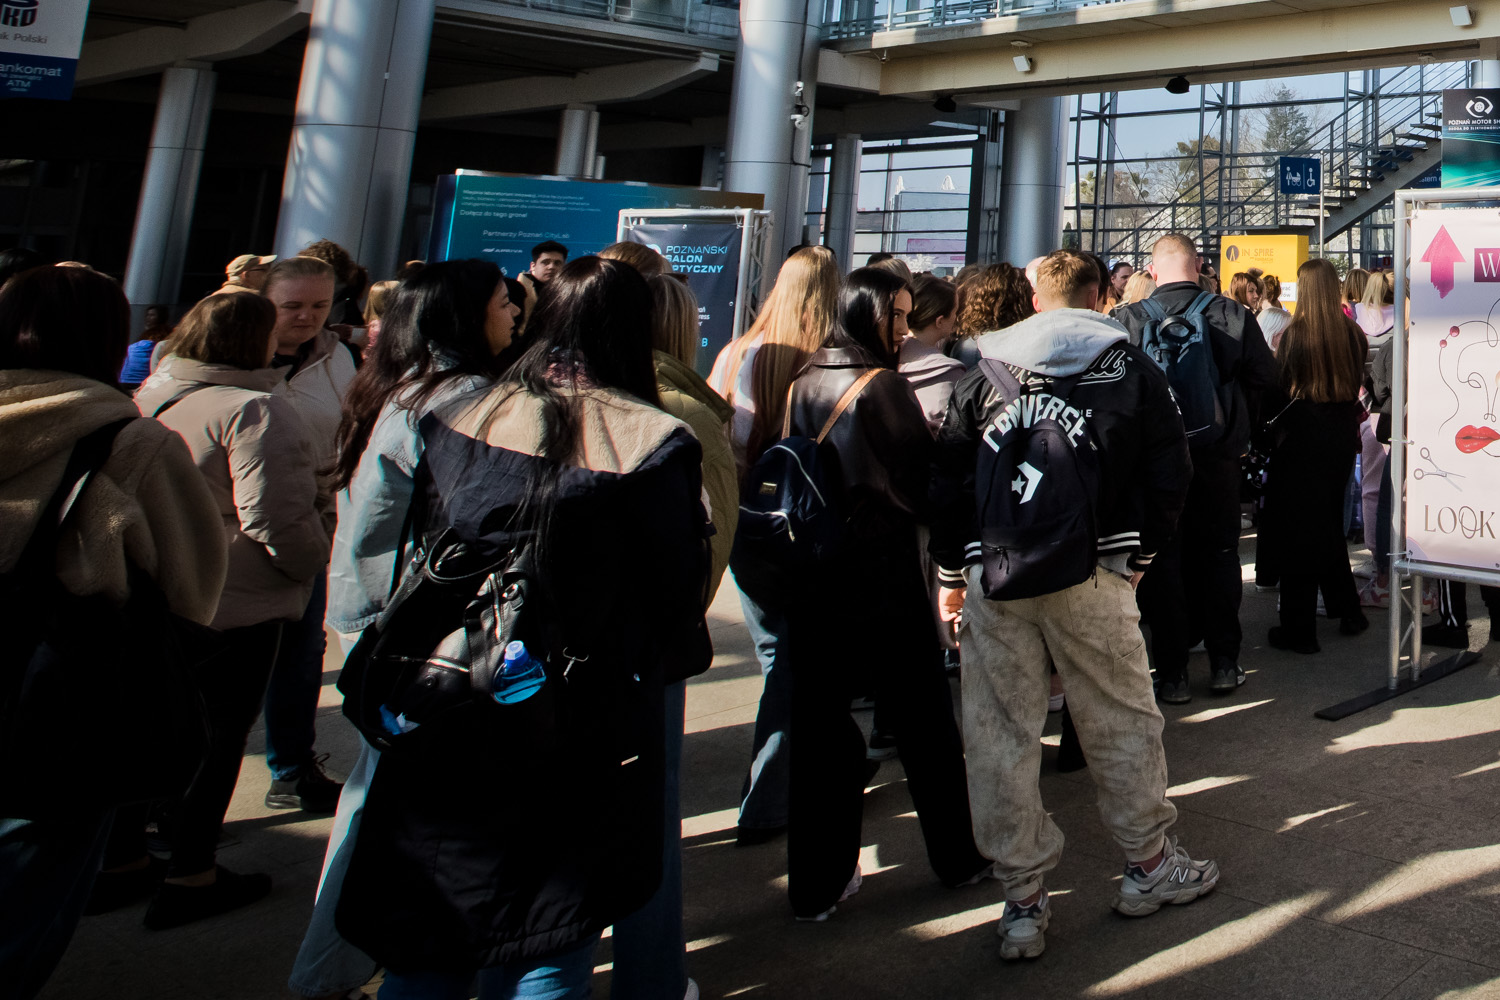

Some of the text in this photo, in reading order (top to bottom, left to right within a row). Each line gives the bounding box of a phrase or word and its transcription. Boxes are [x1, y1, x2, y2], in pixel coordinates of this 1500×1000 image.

[14, 33, 48, 44] Polski
[0, 63, 62, 77] ankomat
[6, 80, 31, 88] ATM
[483, 229, 517, 238] Partnerzy
[666, 244, 728, 254] POZNAŃSKI
[666, 254, 703, 263] SALON
[672, 264, 724, 274] PTYCZNY
[701, 337, 709, 347] B
[982, 393, 1087, 453] CONVERSE
[1424, 504, 1496, 539] LOOK
